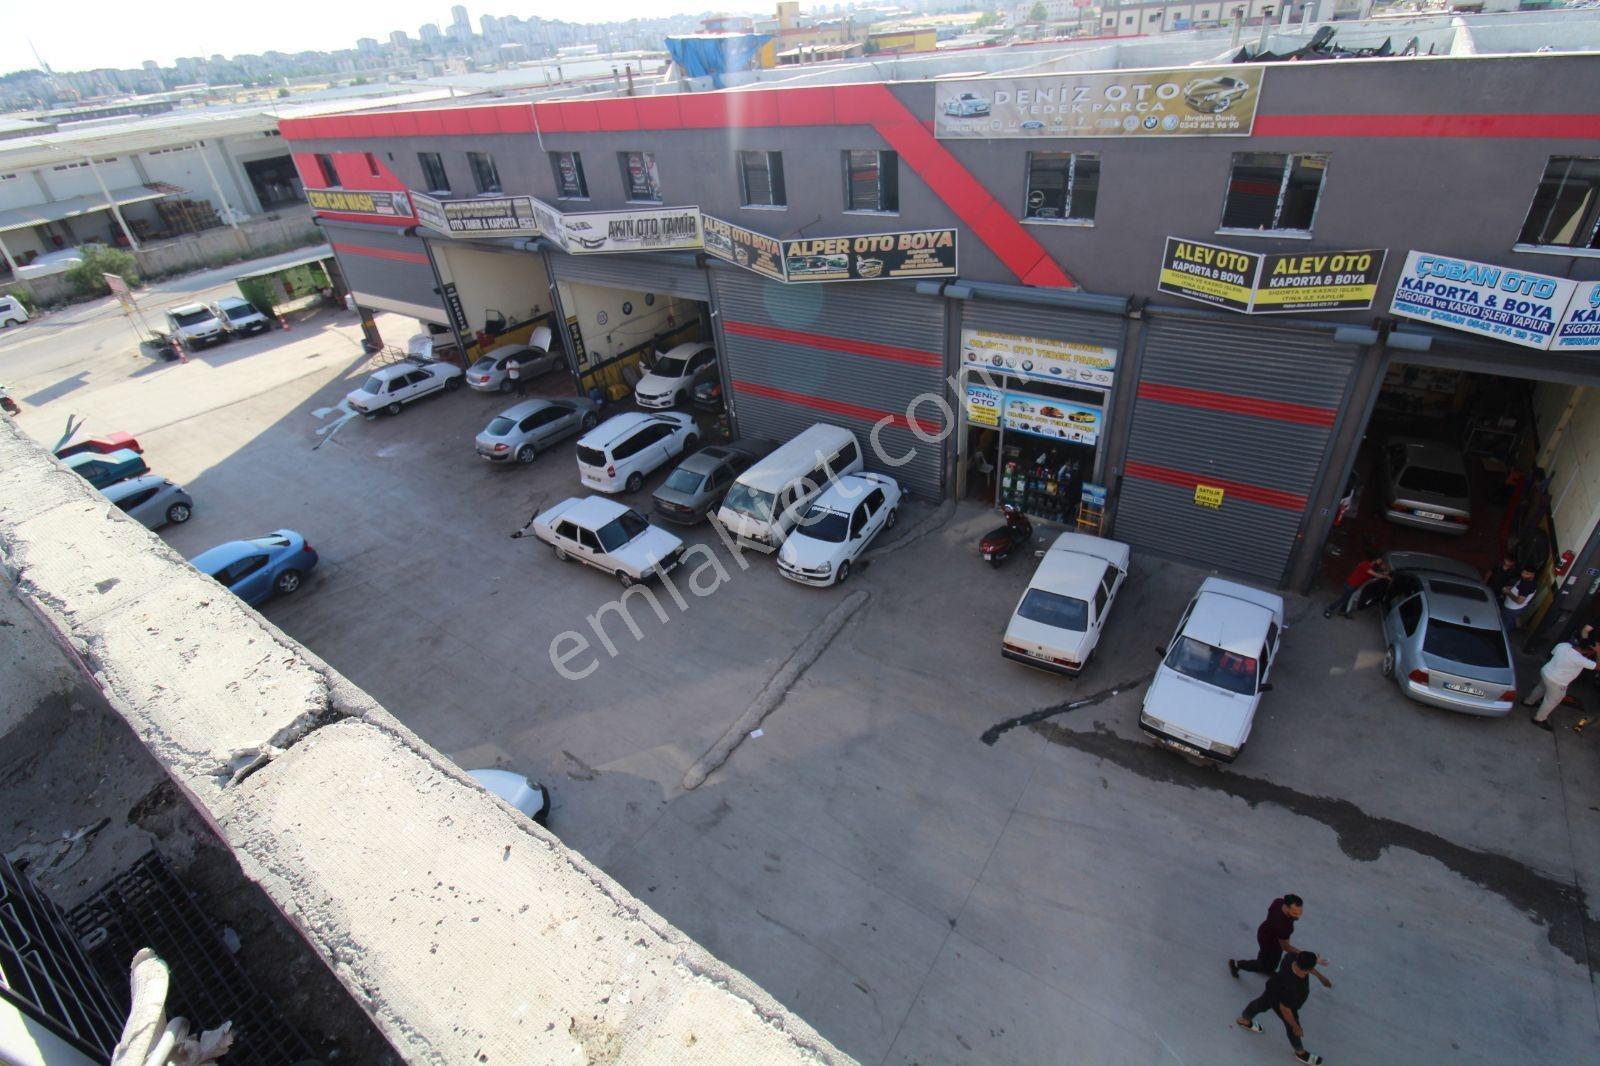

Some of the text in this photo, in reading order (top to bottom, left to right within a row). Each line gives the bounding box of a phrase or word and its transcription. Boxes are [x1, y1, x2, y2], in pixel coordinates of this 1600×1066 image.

[994, 82, 1180, 105] DENİZ OTO
[1017, 103, 1082, 115] YEDEK
[449, 219, 464, 230] OTO
[488, 217, 519, 229] KAPORTA
[637, 218, 658, 235] OTO
[704, 217, 732, 239] ALPER
[731, 227, 751, 246] OTO
[751, 234, 781, 256] BOYA
[787, 231, 953, 256] ALPER OTO BOYA
[1174, 242, 1249, 273] ALEV OTO
[1273, 254, 1371, 275] ALEV OTO
[1172, 260, 1245, 286] KAPORTA & BOYA
[1269, 274, 1365, 288] KAPORTA & BOYA
[1415, 255, 1501, 288] ÇOBAN
[1500, 271, 1557, 300] OTO
[1401, 277, 1552, 320] KAPORTA & BOYA
[1430, 308, 1465, 325] ÇOBAN
[1530, 332, 1544, 344] 72
[1436, 301, 1447, 309] ve
[1447, 301, 1480, 317] KASKO
[1511, 315, 1550, 333] YAPILIR
[971, 396, 996, 407] OTO
